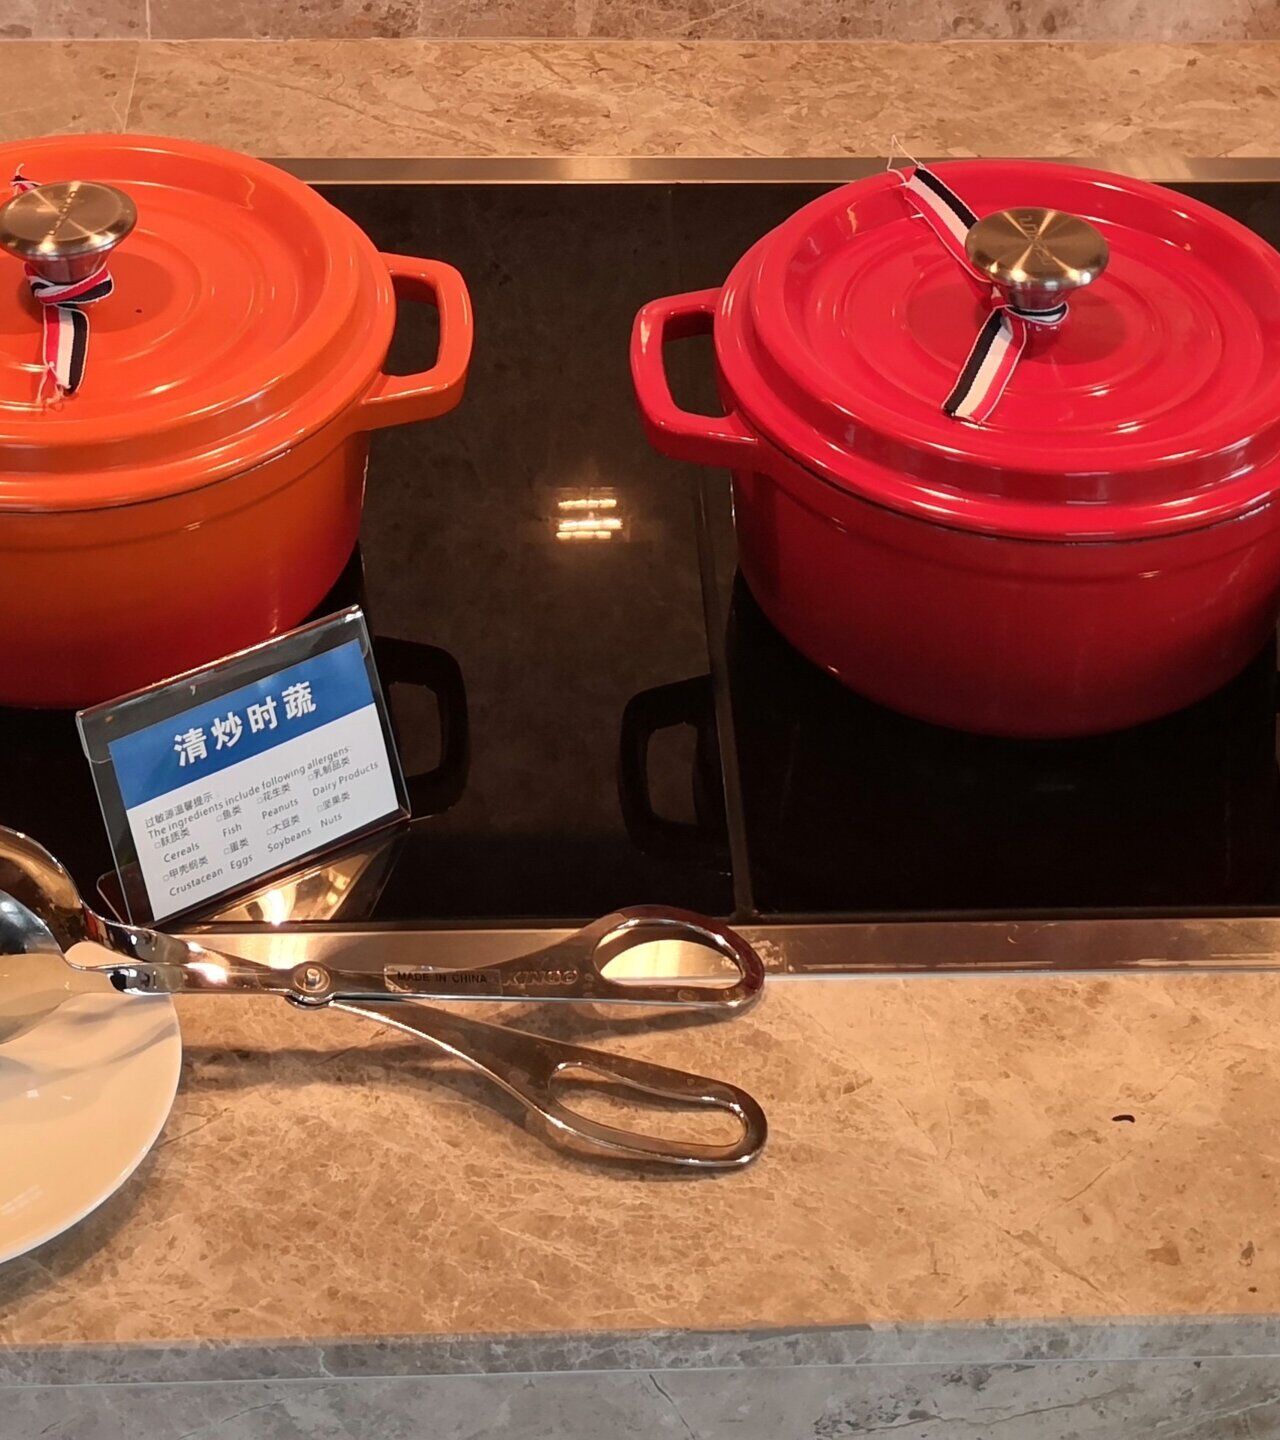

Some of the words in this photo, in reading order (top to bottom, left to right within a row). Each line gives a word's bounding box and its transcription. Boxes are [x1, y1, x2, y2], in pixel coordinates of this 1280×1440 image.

[173, 680, 317, 767] 清炒时蔬
[148, 827, 166, 839] The
[169, 801, 223, 830] ingredients
[225, 786, 260, 806] include
[262, 766, 305, 789] following
[163, 842, 200, 863] Cereals
[222, 823, 242, 837] Fish
[262, 798, 299, 819] Peanuts
[312, 780, 337, 797] Dairy
[339, 761, 379, 784] Products
[169, 867, 224, 897] Crustacean
[230, 854, 253, 870] Eggs
[267, 827, 312, 853] Soybeans
[320, 813, 343, 828] Nuts
[397, 971, 432, 983] MADE
[435, 973, 447, 983] IN
[451, 973, 488, 985] CHINA
